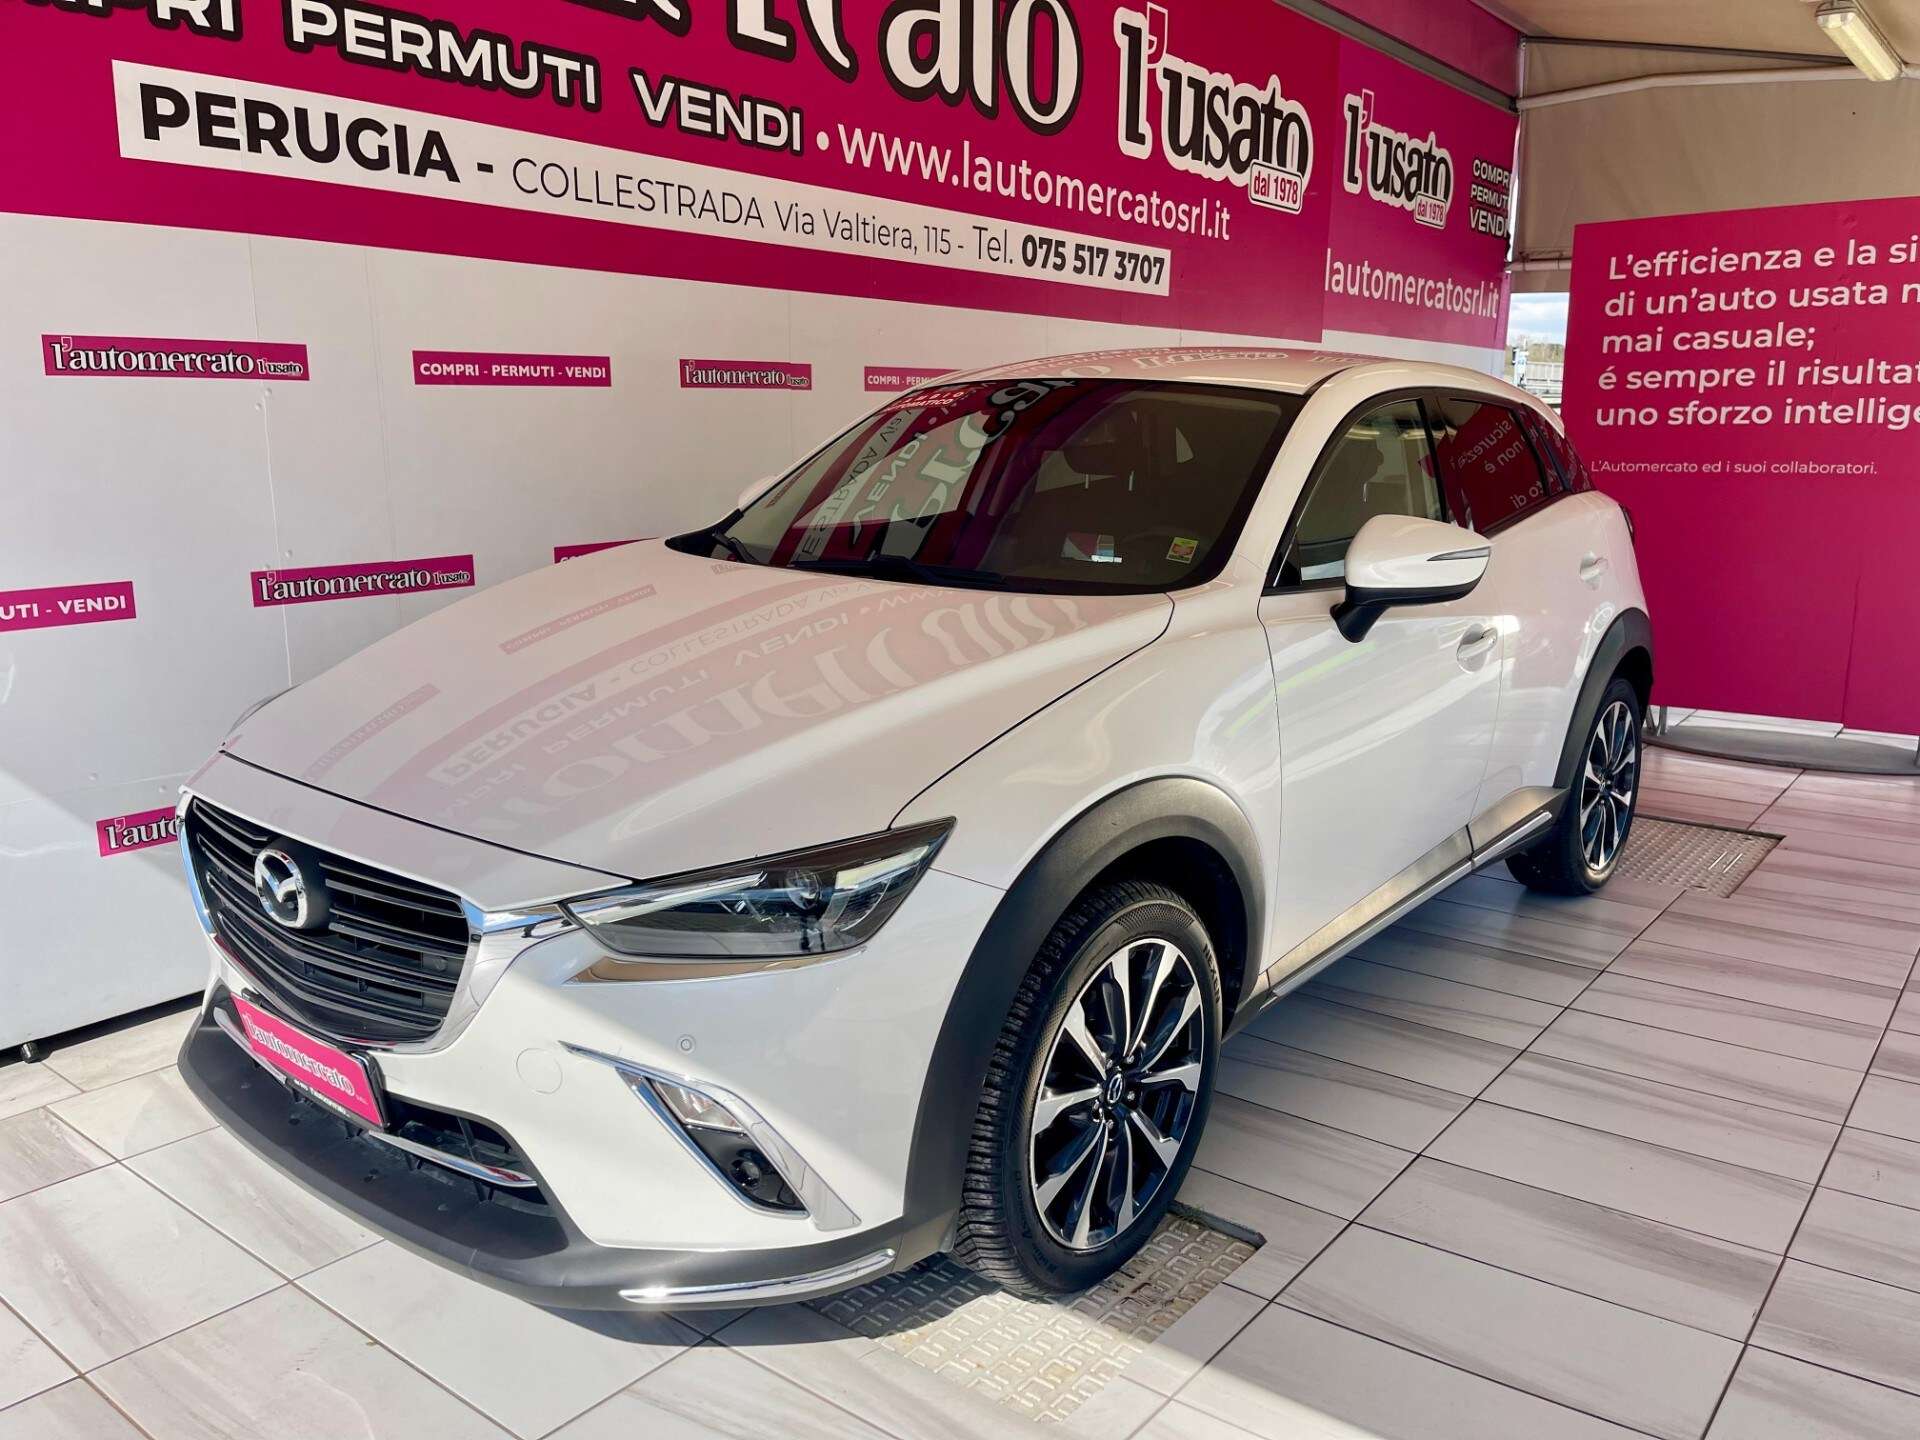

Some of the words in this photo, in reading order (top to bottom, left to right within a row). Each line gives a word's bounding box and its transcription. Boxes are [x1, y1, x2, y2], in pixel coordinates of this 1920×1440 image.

[290, 0, 599, 105] PERMUTI
[632, 71, 803, 153] VENDI
[1118, 2, 1311, 178] l'usato
[1346, 88, 1452, 201] l'usato
[138, 82, 462, 184] PERUGIA
[511, 157, 765, 229] COLLESTRADA
[773, 199, 815, 236] Via
[822, 208, 918, 256] Valtiera,
[924, 226, 952, 256] 115
[972, 224, 1013, 265] Tel.
[1021, 234, 1067, 274] 075
[1072, 244, 1109, 278] 517
[1113, 250, 1166, 286] 3707
[836, 123, 1231, 241] www.lautomercatosrl.it
[1253, 170, 1271, 198] dal
[1273, 175, 1299, 205] 1978
[1472, 158, 1511, 188] COMPR
[1416, 200, 1428, 218] dal
[1428, 203, 1445, 222] 1978
[1470, 184, 1509, 209] PERMUT
[1608, 246, 1803, 280] L'efficienza
[1813, 246, 1836, 267] e
[1846, 238, 1877, 266] la
[1888, 234, 1920, 264] si
[1604, 290, 1636, 317] di
[1645, 287, 1777, 315] un'auto
[1788, 281, 1889, 308] usata
[1601, 326, 1664, 354] mai
[1672, 321, 1817, 352] casuale;
[50, 336, 254, 374] l'automercato
[419, 362, 480, 377] COMPRI
[491, 364, 555, 378] PERMUTI
[564, 365, 607, 379] VENDI
[684, 359, 785, 386] l'automercato
[867, 375, 900, 386] COMPRI
[1598, 365, 1617, 391] é
[1625, 366, 1756, 394] sempre
[1766, 359, 1786, 387] il
[1595, 406, 1659, 427] uno
[1667, 400, 1774, 426] sforzo
[1590, 460, 1699, 474] L'Automercato
[1702, 460, 1722, 474] ed
[1725, 461, 1731, 474] i
[1734, 461, 1767, 474] suoi
[1770, 461, 1879, 475] collaboratori.
[56, 594, 128, 615] VENDI
